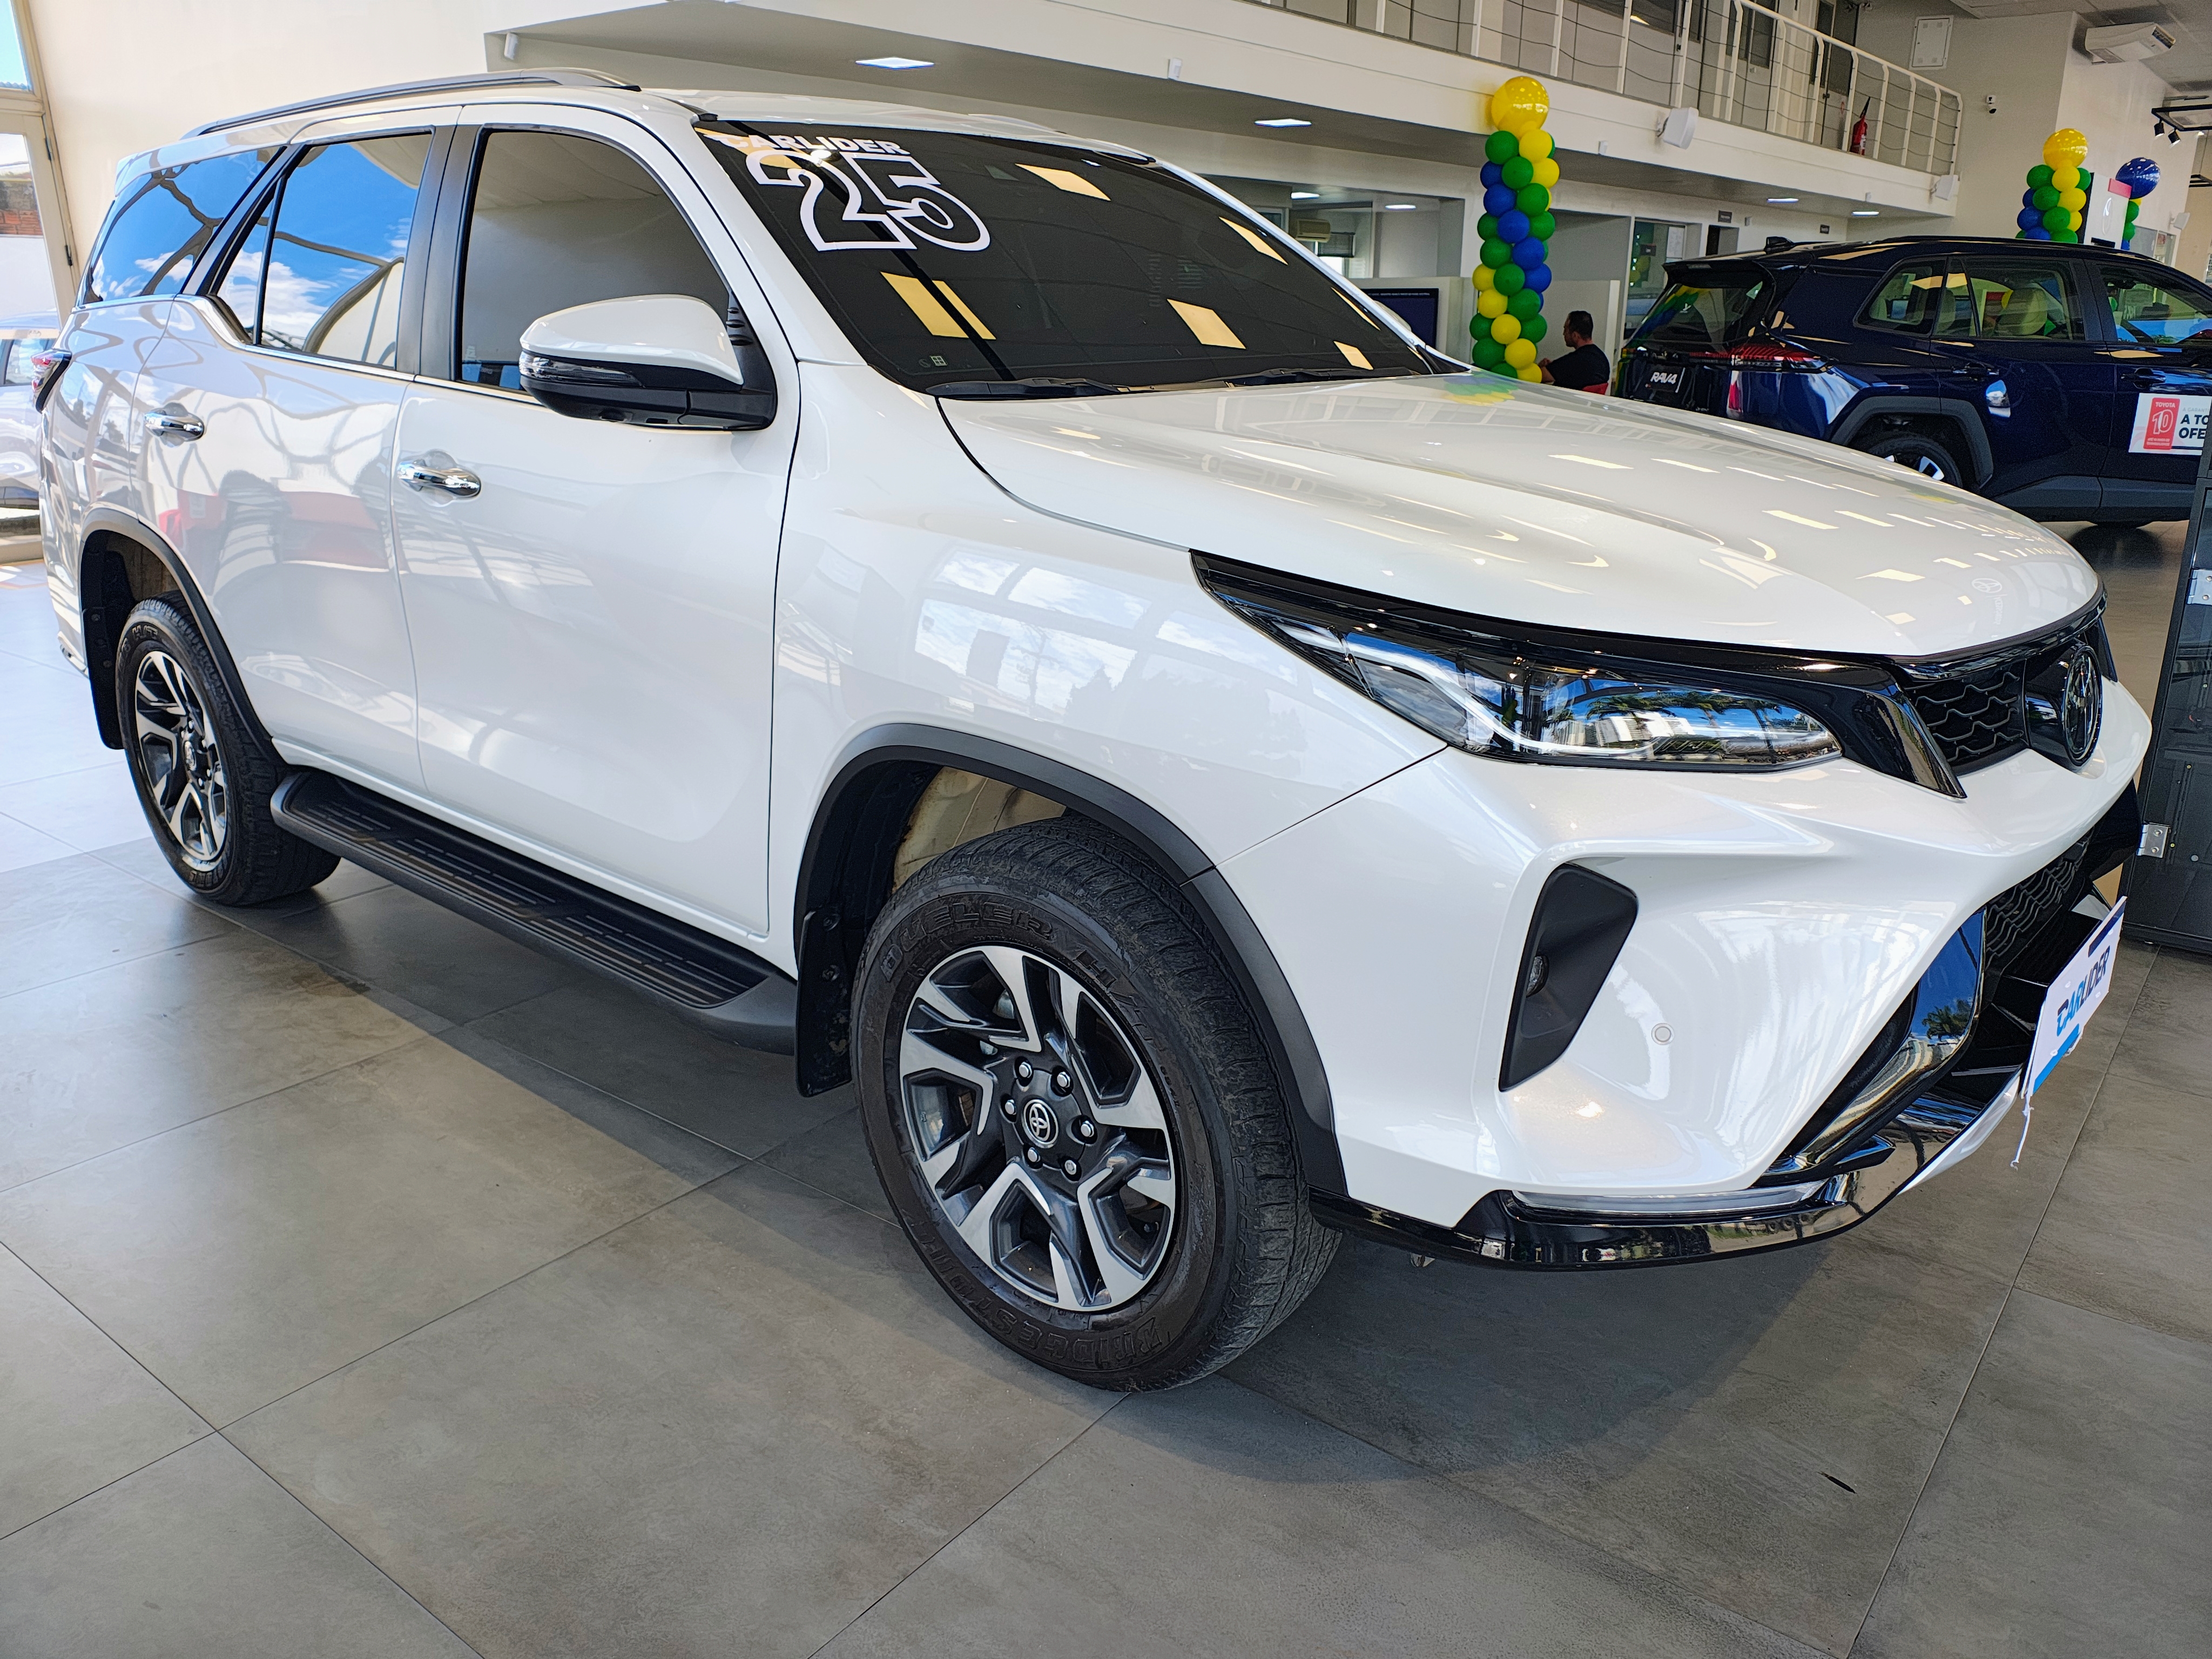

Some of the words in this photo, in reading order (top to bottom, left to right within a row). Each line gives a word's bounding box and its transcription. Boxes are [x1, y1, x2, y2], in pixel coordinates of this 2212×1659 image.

[703, 134, 911, 155] CARLIDER
[746, 150, 990, 251] 25
[1650, 372, 1677, 384] RAV4
[2152, 409, 2174, 435] 10
[2180, 414, 2190, 424] A
[2179, 427, 2207, 439] OFE
[880, 902, 1052, 982] DUELER
[2056, 945, 2110, 1037] CARLIDER
